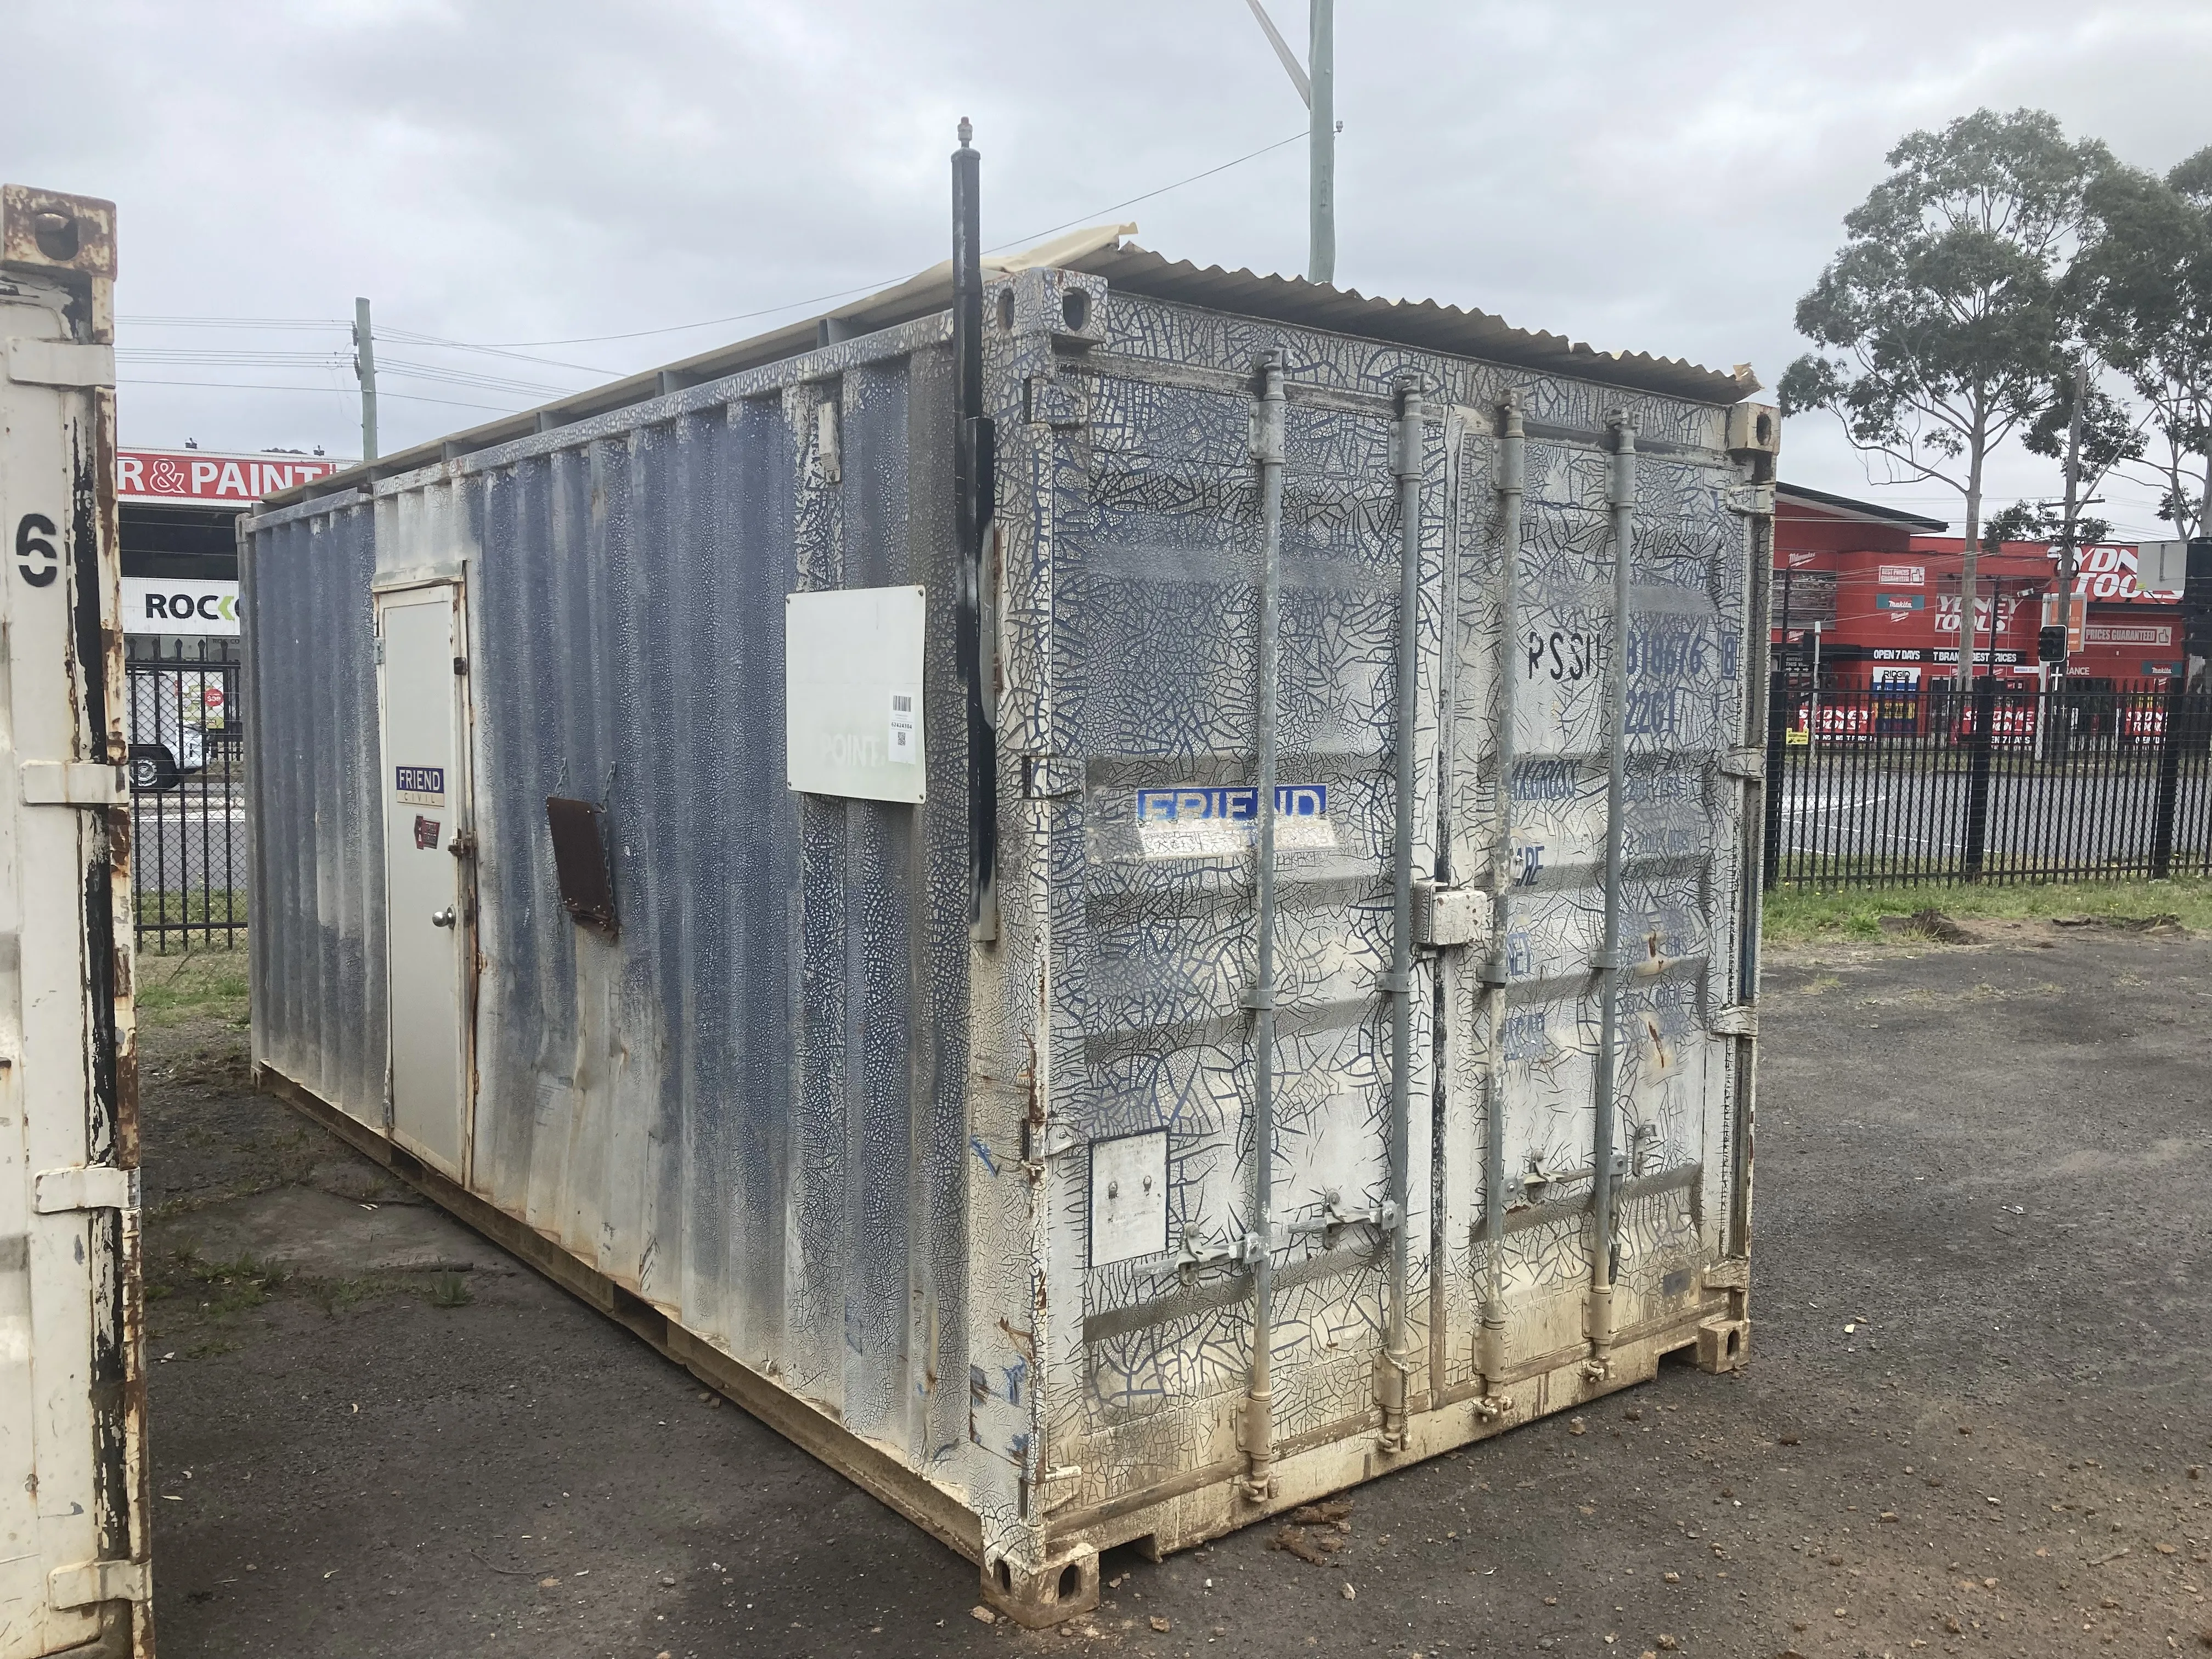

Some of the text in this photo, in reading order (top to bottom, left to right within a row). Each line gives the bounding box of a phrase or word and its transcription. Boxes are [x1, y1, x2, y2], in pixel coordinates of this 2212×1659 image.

[191, 461, 323, 497] PAINT
[16, 513, 58, 588] 6
[2086, 628, 2155, 642] PRICES GUARANTEED
[1874, 650, 1920, 660] OPEN 7 DAYS
[398, 769, 441, 791] FRIEND
[404, 792, 435, 804] CIVIL
